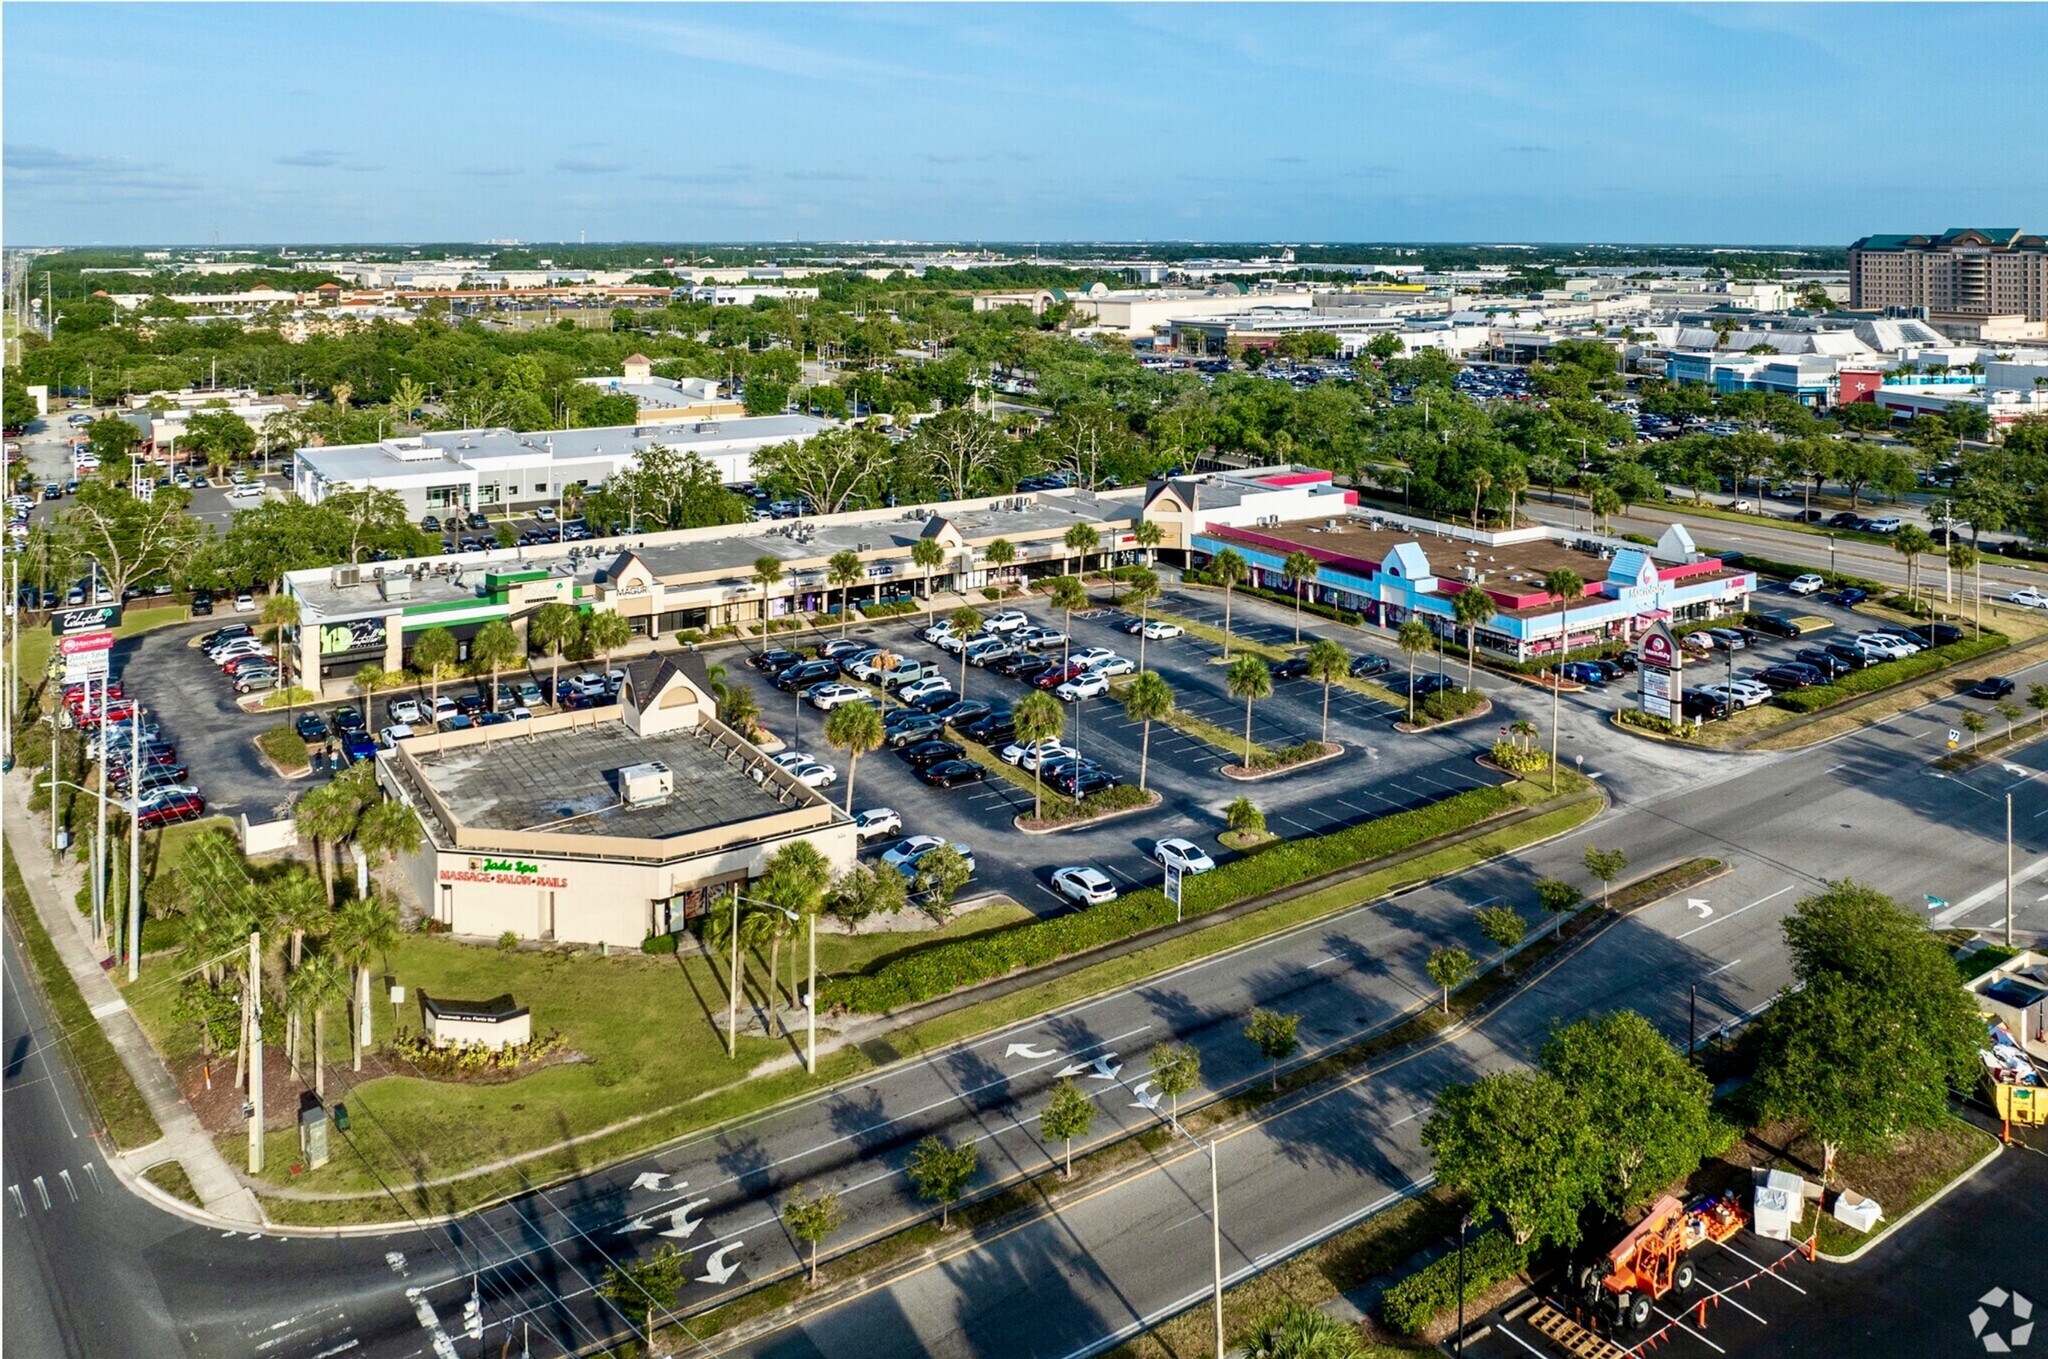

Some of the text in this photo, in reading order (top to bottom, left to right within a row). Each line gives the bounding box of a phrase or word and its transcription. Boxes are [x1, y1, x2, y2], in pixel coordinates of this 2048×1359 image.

[483, 858, 538, 875] Jade Spa
[440, 870, 568, 888] MASSAGE SALON NAILS
